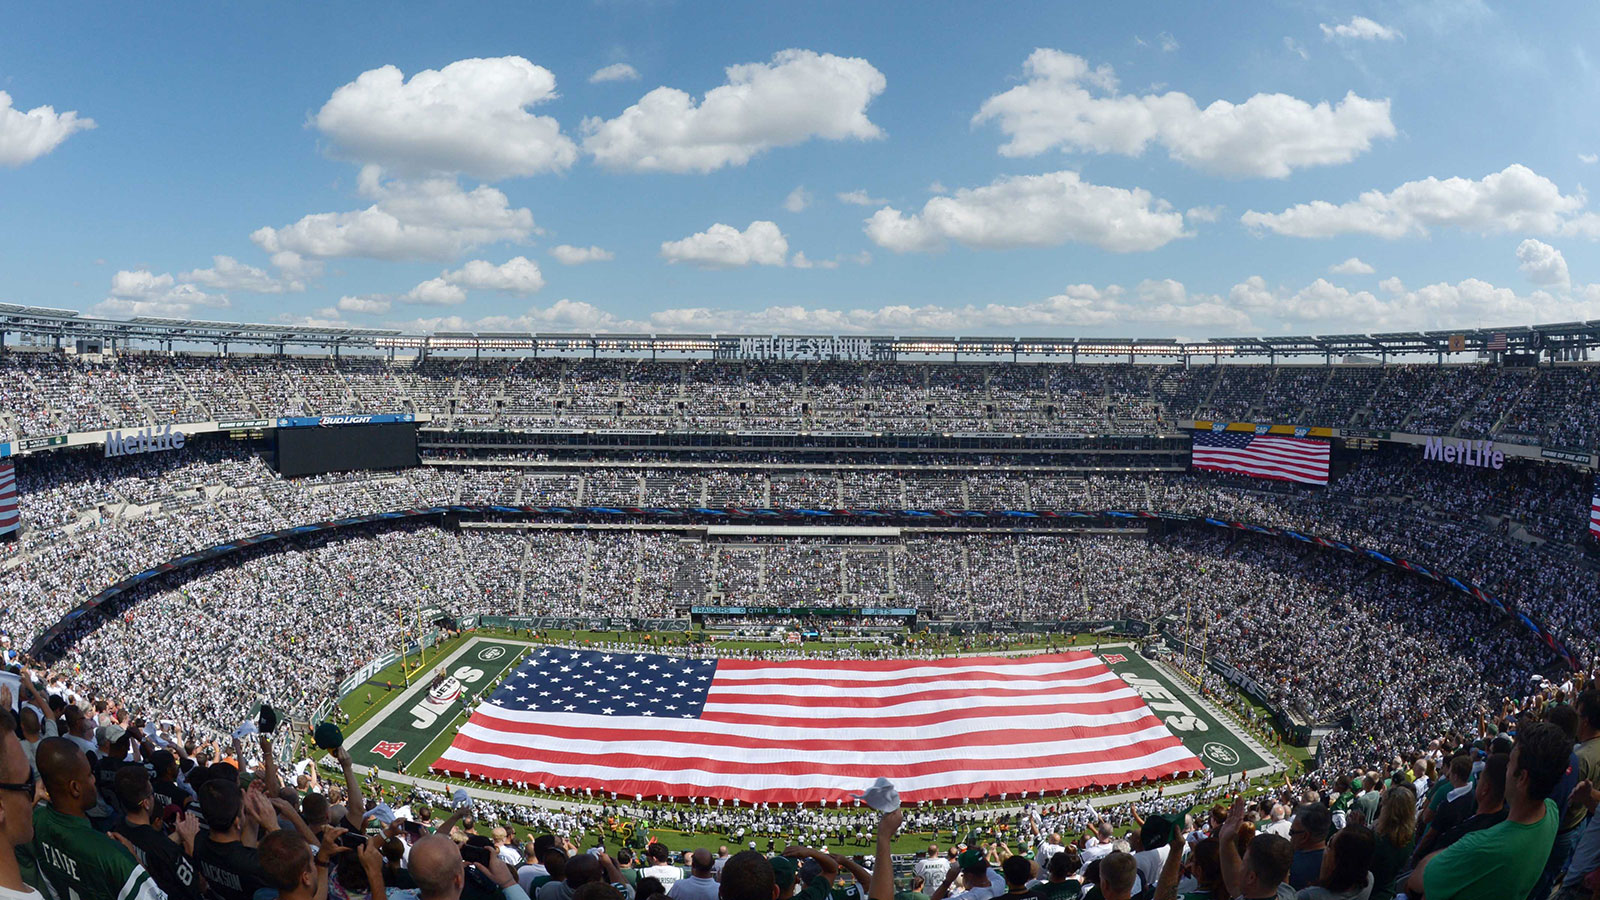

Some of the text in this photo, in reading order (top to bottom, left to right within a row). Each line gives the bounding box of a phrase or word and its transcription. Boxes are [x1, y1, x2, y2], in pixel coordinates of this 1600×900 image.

[740, 337, 873, 355] METLIFE STADIUM
[322, 416, 372, 425] BUD LIGHT
[1212, 424, 1225, 432] SAP
[1255, 426, 1268, 434] SAP
[104, 423, 185, 458] MetLife
[1294, 428, 1307, 436] SAP
[1423, 436, 1504, 470] MetLife
[436, 677, 456, 697] JETS
[1222, 667, 1259, 695] JETS
[409, 665, 485, 730] JS
[1119, 672, 1209, 732] JETS
